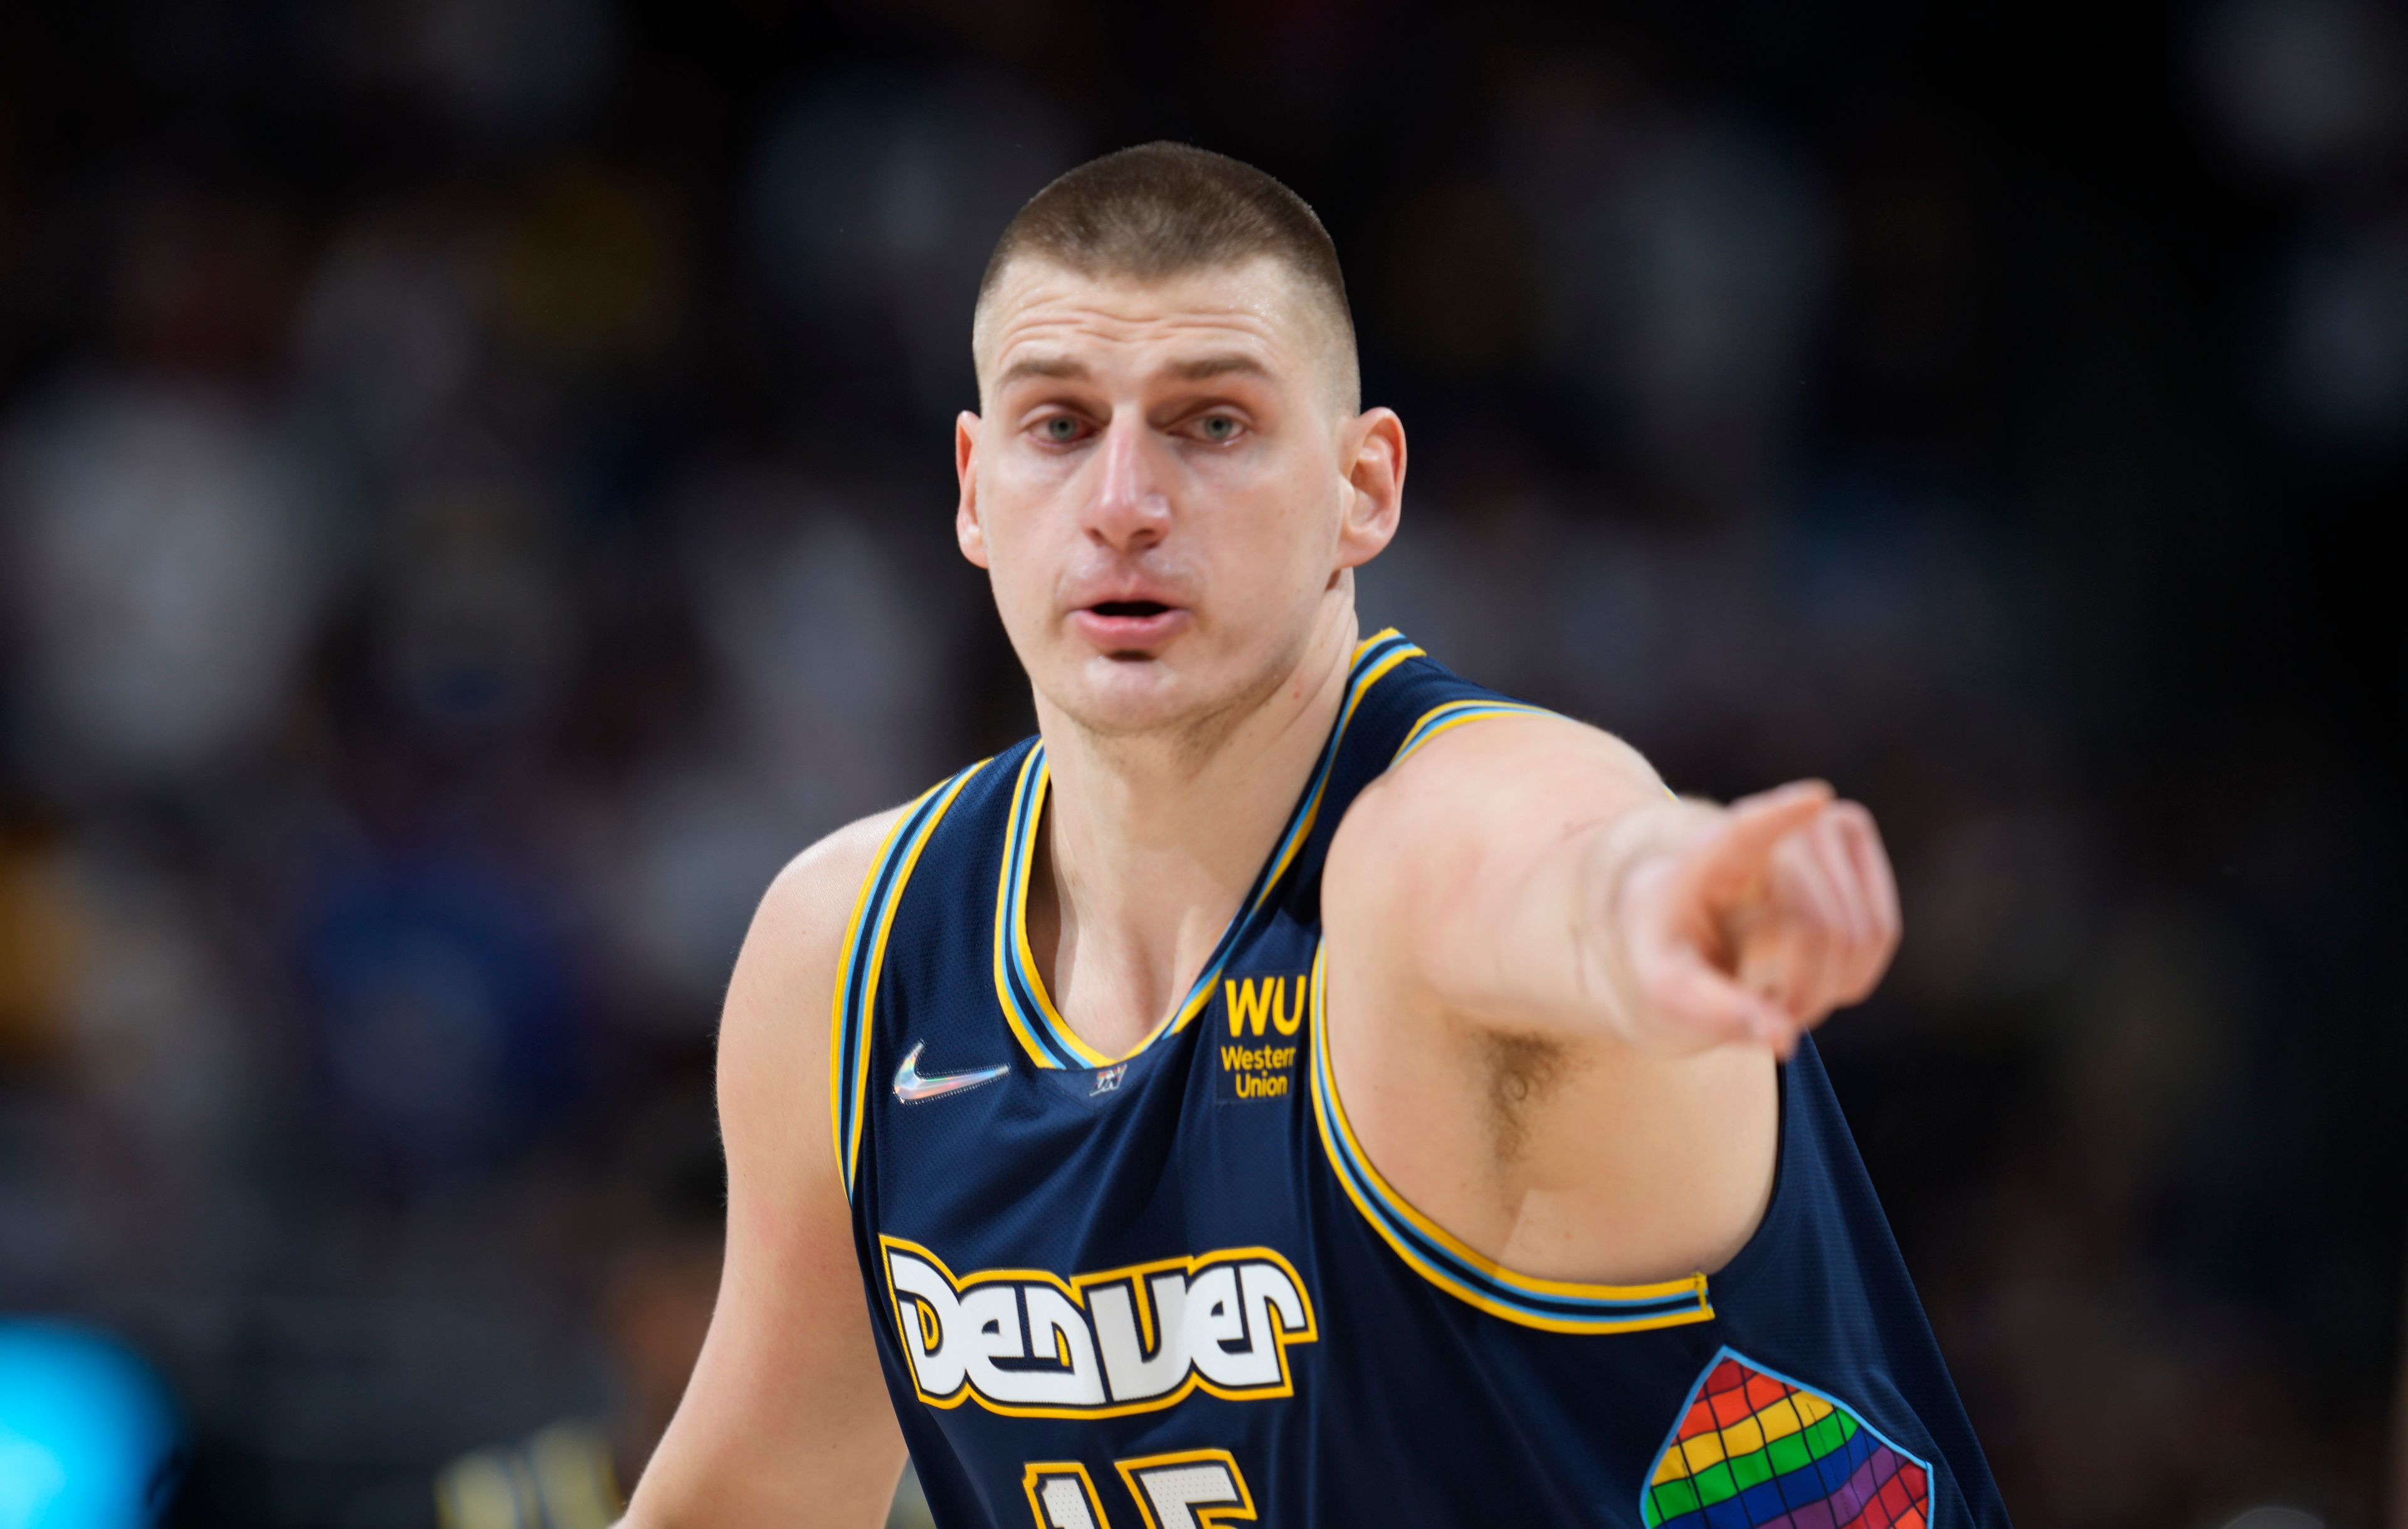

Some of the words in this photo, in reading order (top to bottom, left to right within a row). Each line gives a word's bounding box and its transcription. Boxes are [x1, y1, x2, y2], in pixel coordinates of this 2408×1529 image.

[1225, 975, 1306, 1037] WU
[1235, 1070, 1287, 1098] Union
[879, 1234, 1318, 1420] Denver
